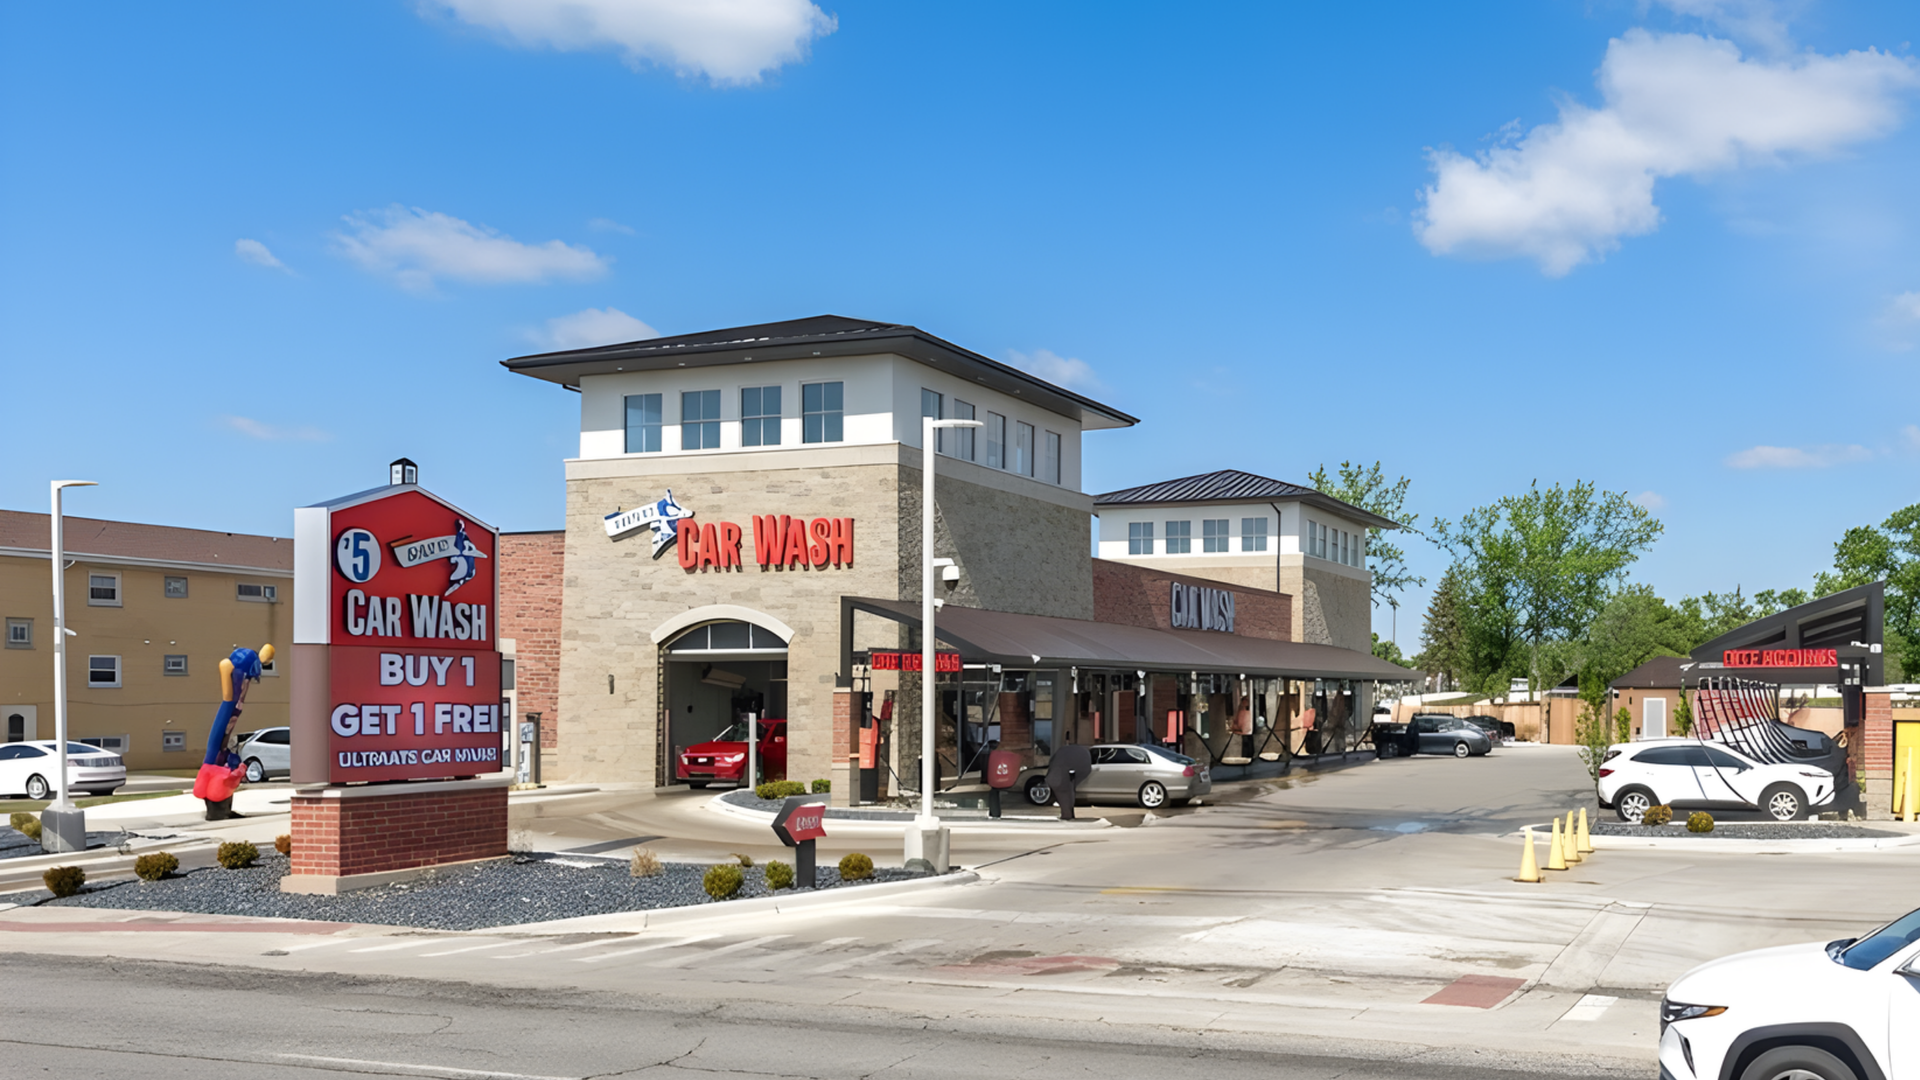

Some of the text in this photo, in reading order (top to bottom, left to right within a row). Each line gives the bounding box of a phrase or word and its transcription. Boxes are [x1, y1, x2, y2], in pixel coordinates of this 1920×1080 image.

[677, 517, 742, 569] CAR
[752, 514, 854, 567] WASH
[347, 588, 487, 641] CAR WASH
[380, 653, 475, 687] BUY 1
[331, 703, 402, 737] GET
[410, 702, 425, 736] 1
